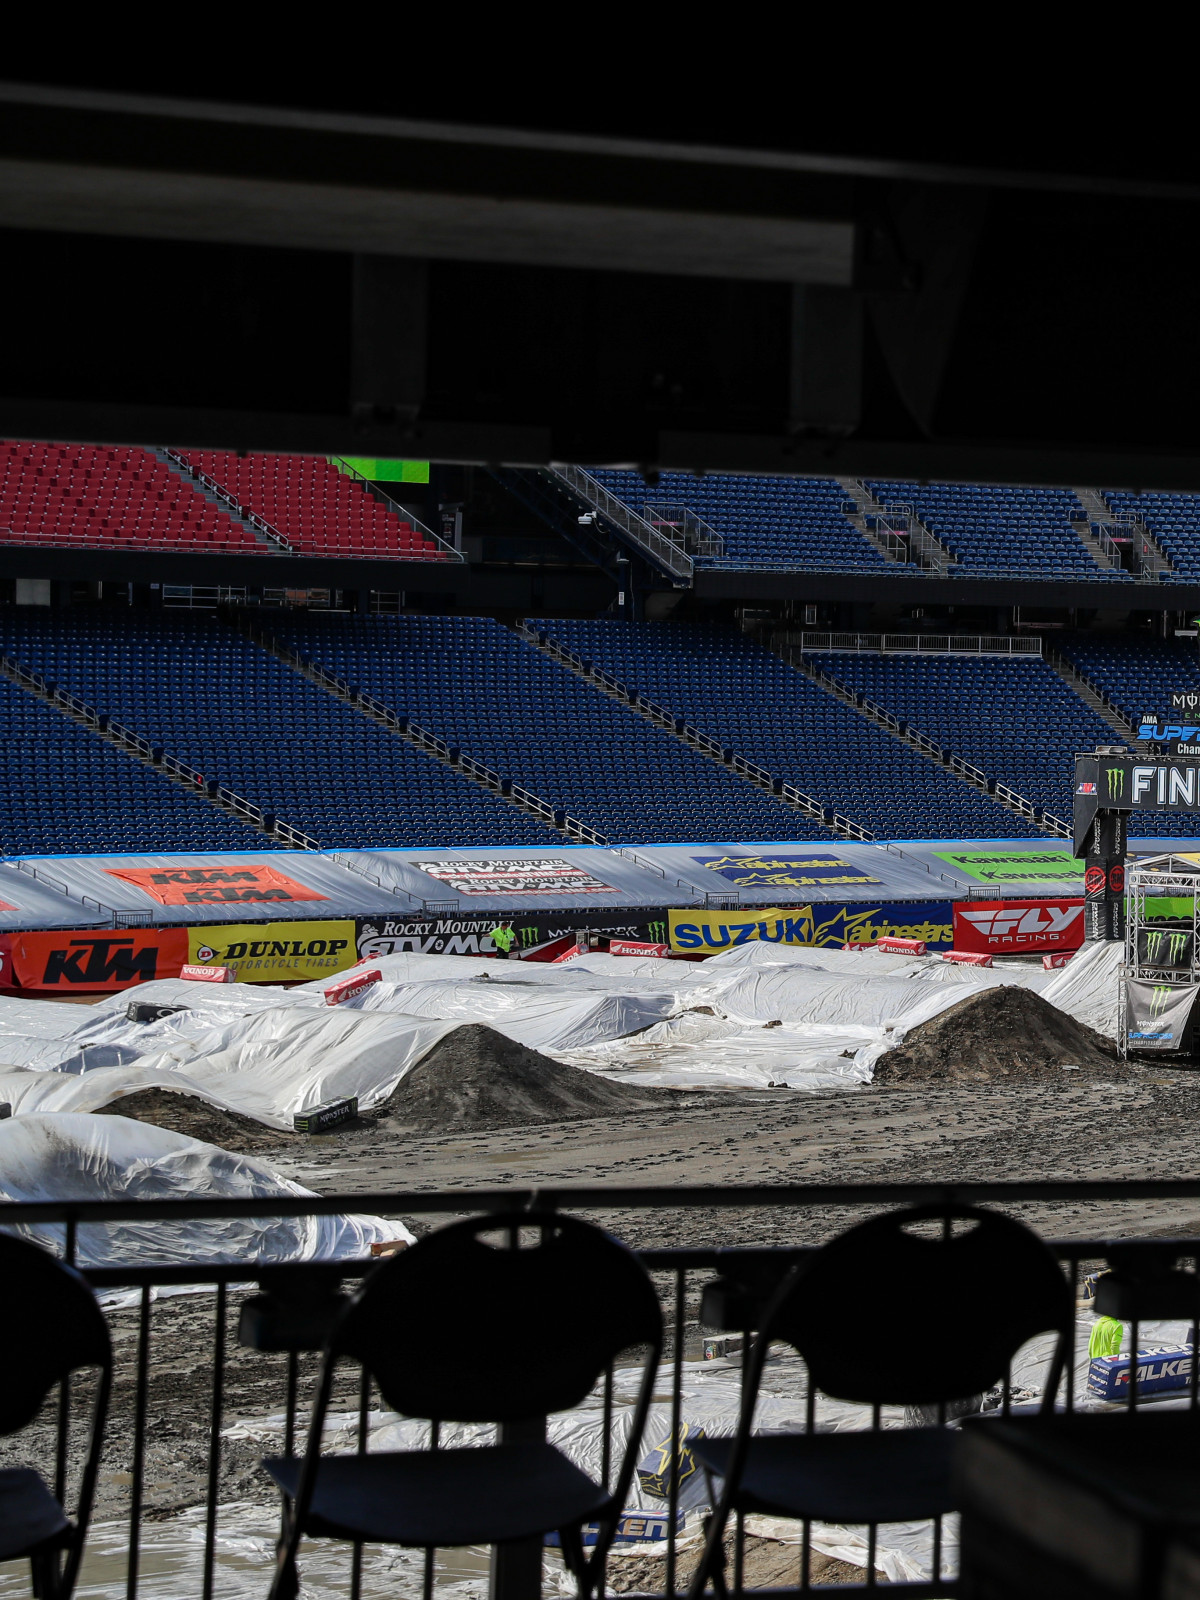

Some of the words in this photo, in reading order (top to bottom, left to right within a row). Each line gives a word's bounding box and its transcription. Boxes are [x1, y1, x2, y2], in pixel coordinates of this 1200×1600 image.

[1142, 715, 1157, 724] AMA
[745, 859, 851, 870] alpinestars
[952, 855, 1071, 864] Kawasaki
[150, 868, 260, 884] KTM
[980, 870, 1086, 879] Kawasak
[774, 876, 881, 887] alpinestars
[183, 886, 293, 902] KTM
[382, 921, 433, 936] ROCKY
[674, 918, 813, 948] SUZUKI
[988, 933, 1060, 944] RACING
[223, 939, 348, 960] DUNLOP
[621, 947, 660, 956] HONDA
[887, 946, 916, 954] HONDA
[42, 938, 159, 985] KTM
[221, 958, 299, 970] MOTORCYCLE
[305, 957, 339, 967] TIRES
[183, 966, 216, 976] HONDA
[347, 979, 380, 998] HOND
[319, 1105, 351, 1123] MONSTER
[1090, 1363, 1110, 1376] FALKEN
[1089, 1373, 1108, 1386] FALKEN
